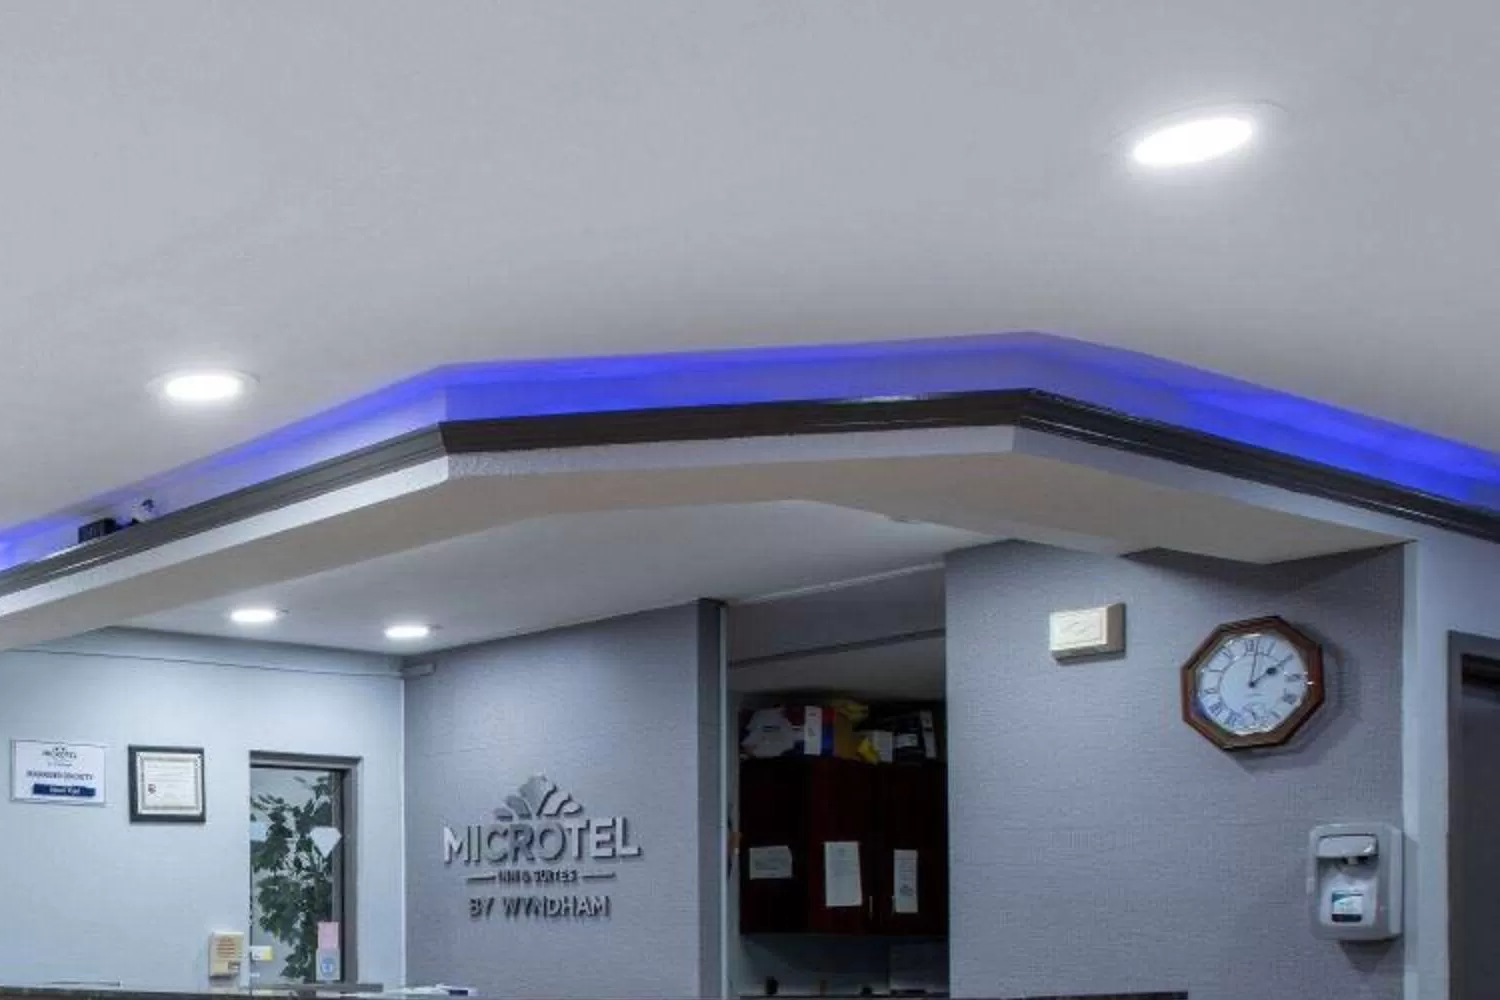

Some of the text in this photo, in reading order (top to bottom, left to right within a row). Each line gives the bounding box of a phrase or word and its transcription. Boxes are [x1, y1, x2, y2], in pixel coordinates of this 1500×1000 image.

[443, 816, 642, 868] MICROTEL
[468, 895, 612, 918] BY WYNDHAM
